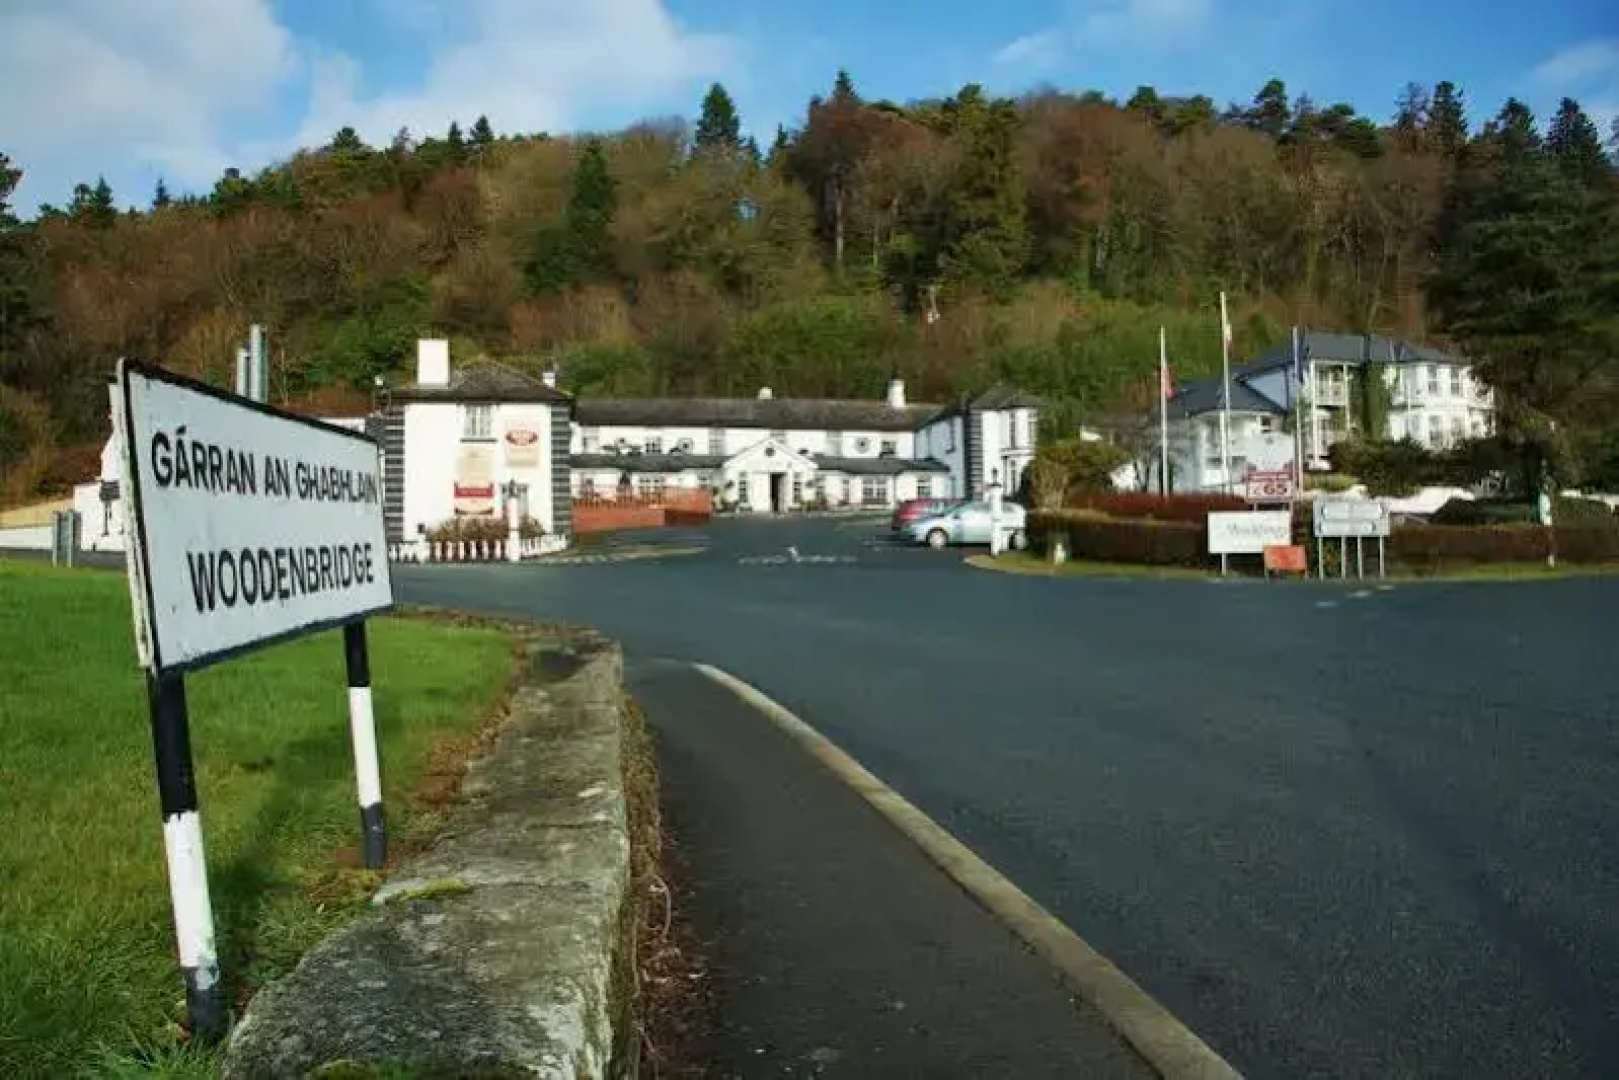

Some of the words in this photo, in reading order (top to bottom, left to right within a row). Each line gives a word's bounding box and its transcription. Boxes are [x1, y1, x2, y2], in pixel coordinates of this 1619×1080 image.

[151, 425, 256, 495] GÁRRAN
[264, 456, 291, 496] AN
[187, 543, 374, 614] WOODENBRIDGE
